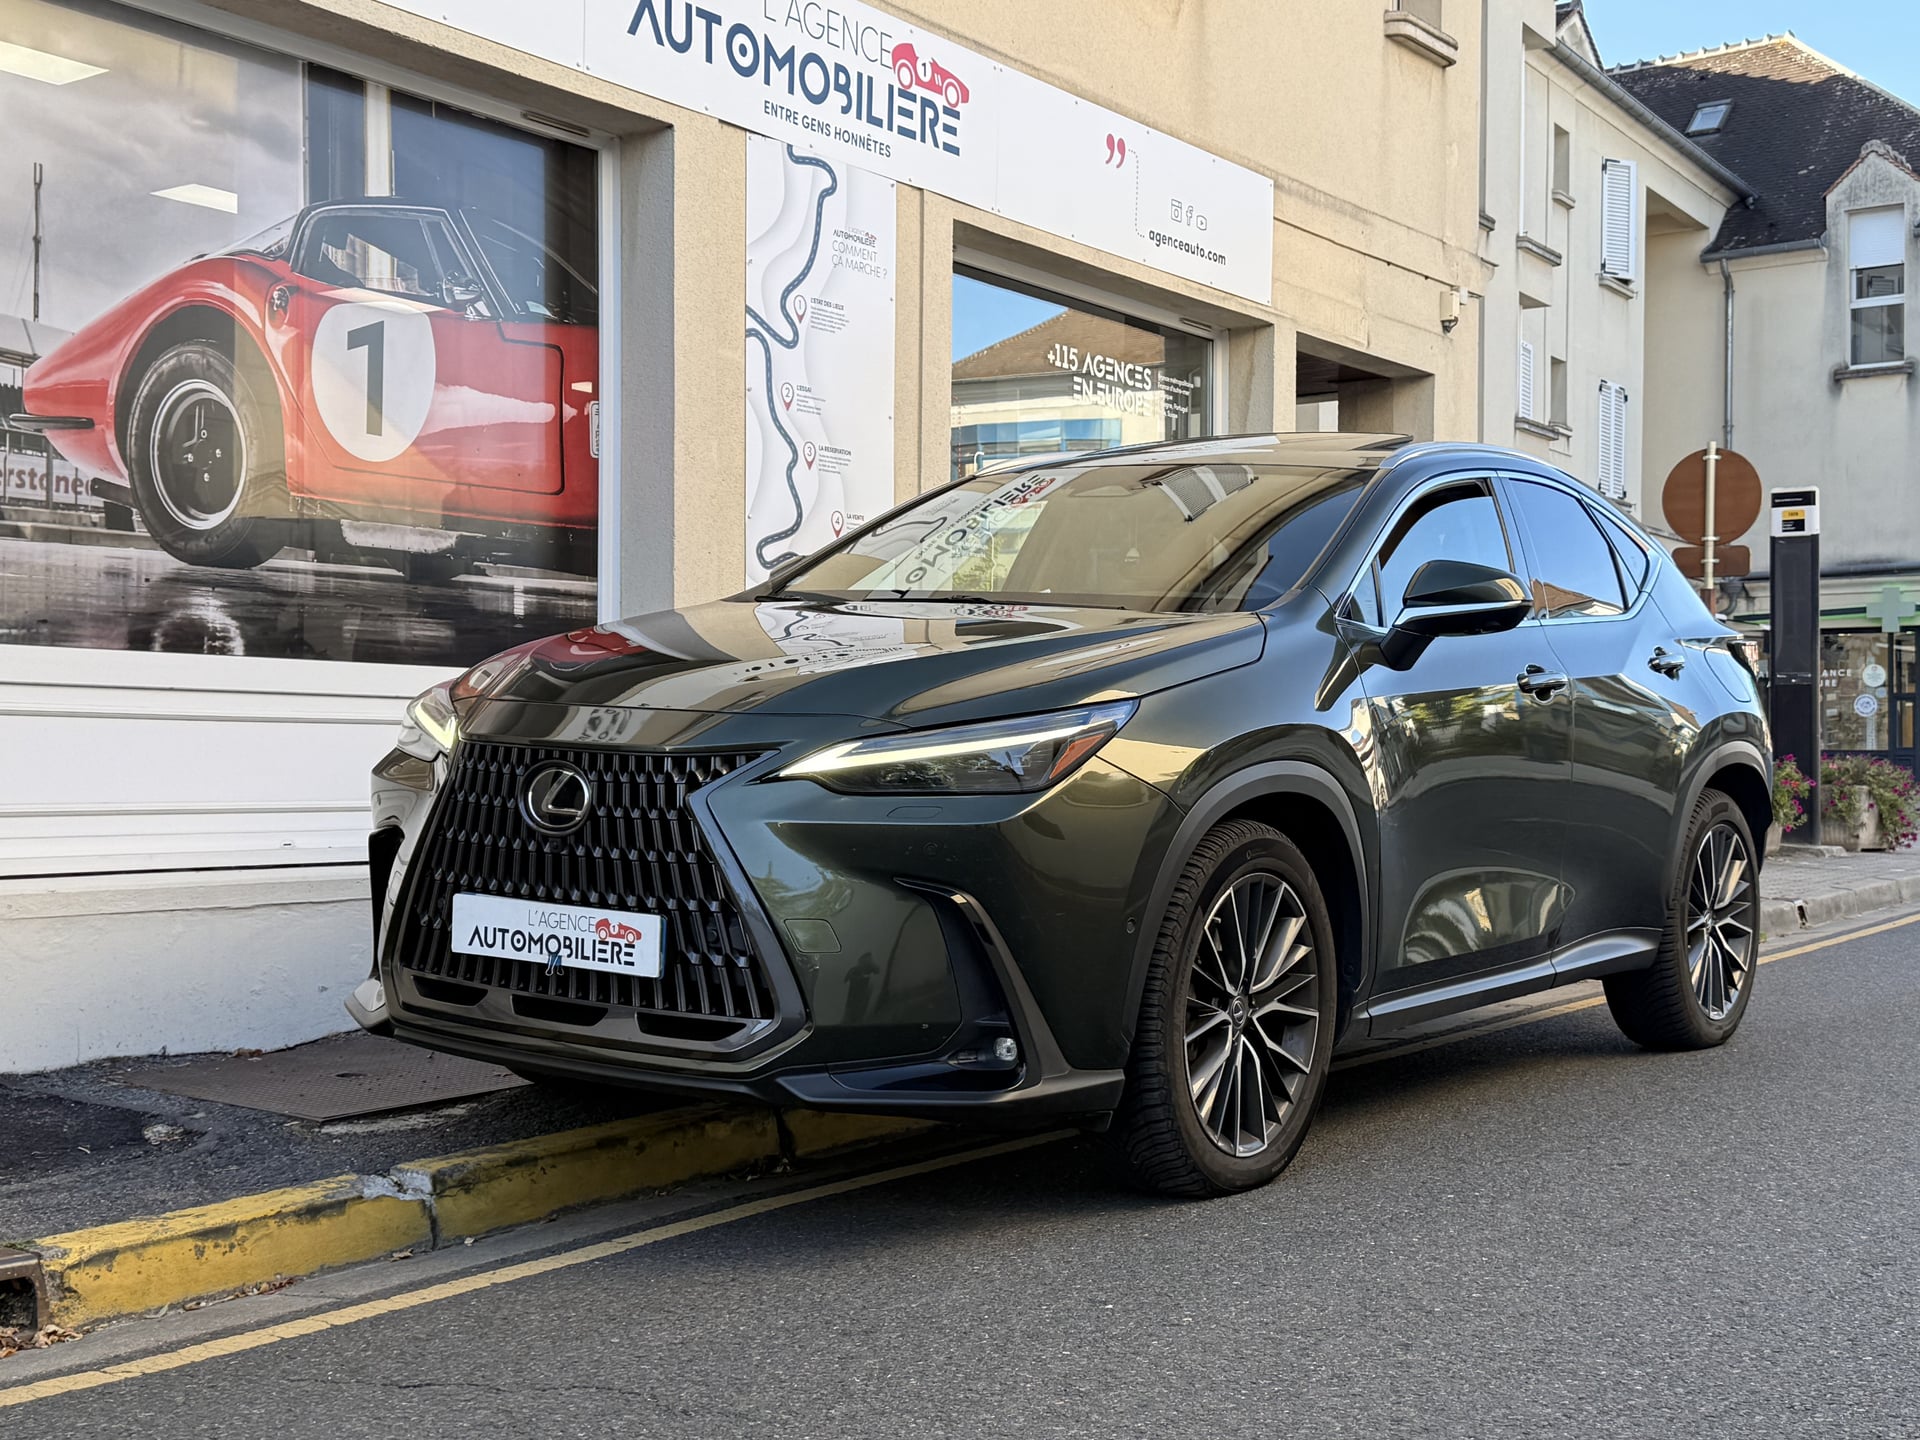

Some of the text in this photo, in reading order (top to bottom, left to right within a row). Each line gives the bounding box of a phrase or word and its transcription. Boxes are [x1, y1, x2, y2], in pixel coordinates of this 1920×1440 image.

[764, 0, 893, 69] LAGENCE
[764, 100, 892, 159] ENTRE GENS HONNÊTES
[832, 240, 878, 262] COMMENT
[1148, 228, 1227, 266] agenceauto.com
[832, 254, 844, 268] ÇA
[845, 258, 881, 278] MARCHE
[347, 320, 385, 437] 1
[1047, 343, 1079, 371] +115
[1082, 352, 1152, 391] AGENCES
[784, 386, 791, 399] 2
[1073, 376, 1094, 402] EN
[1096, 382, 1150, 417] EUROPE
[806, 446, 813, 457] 3
[834, 515, 841, 525] 4
[527, 908, 597, 934] L'AGENCE
